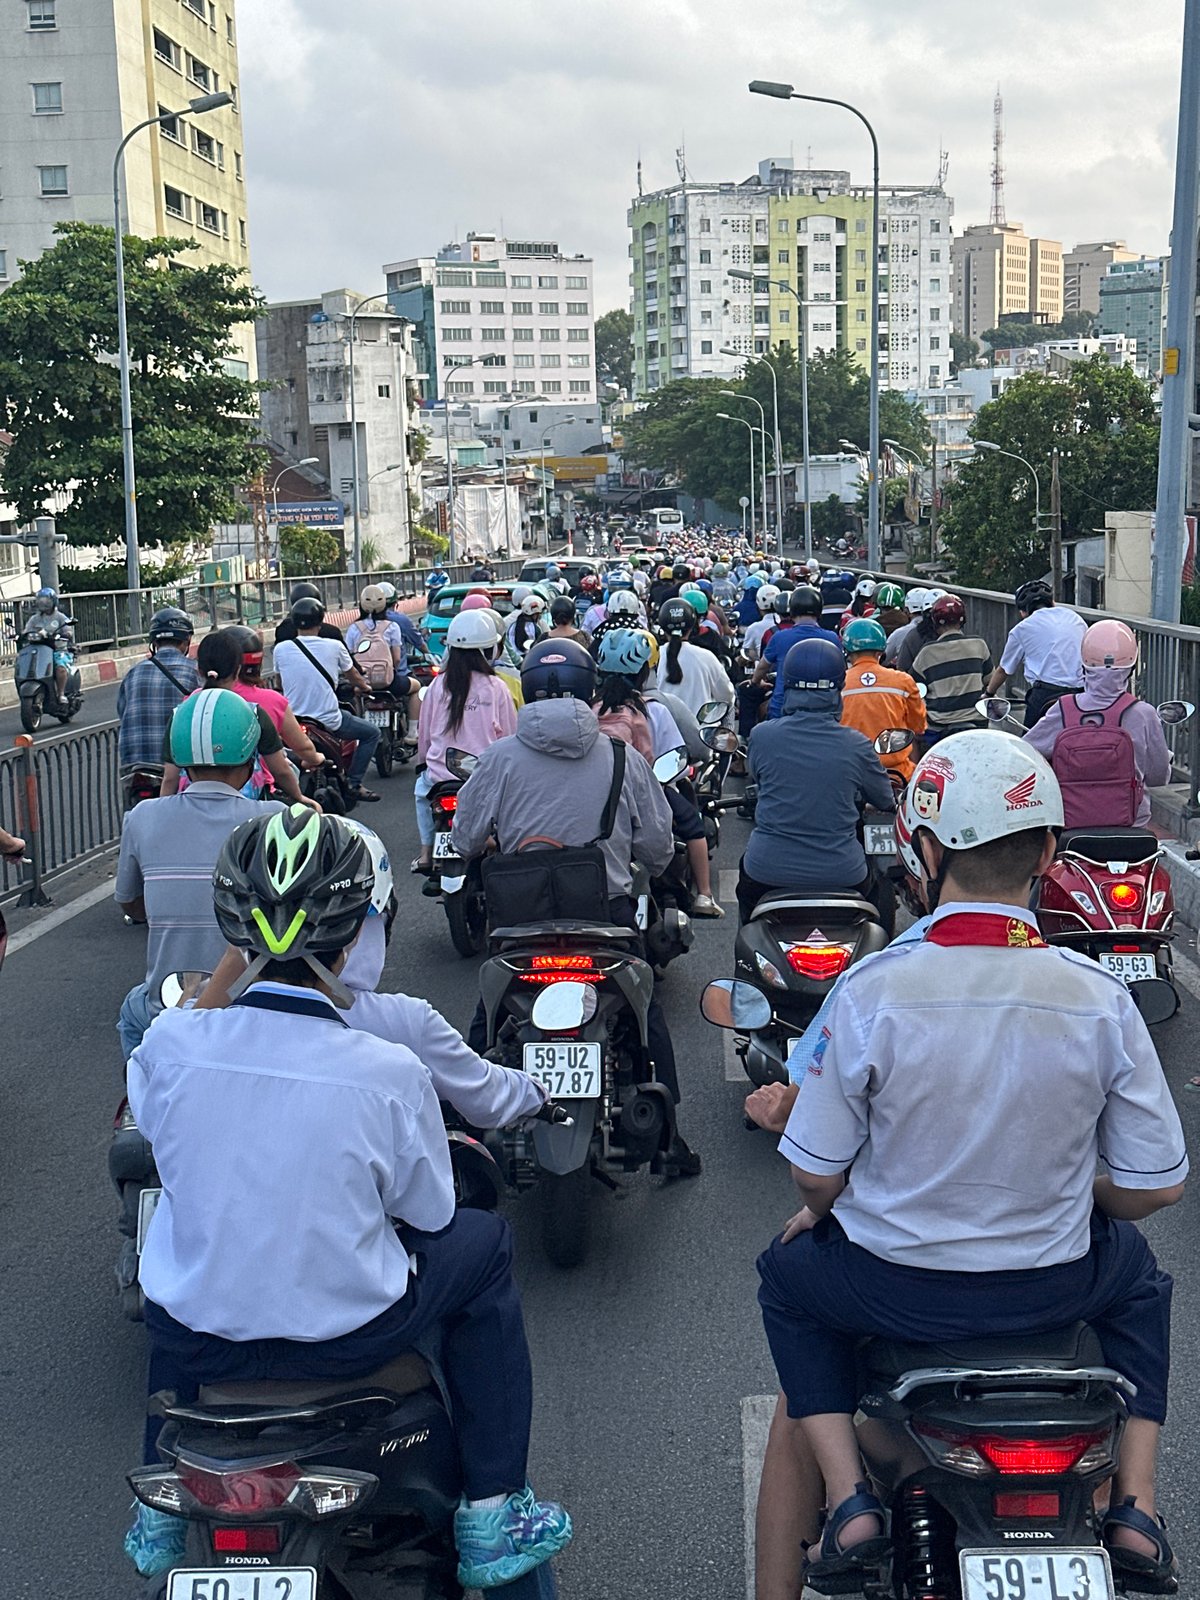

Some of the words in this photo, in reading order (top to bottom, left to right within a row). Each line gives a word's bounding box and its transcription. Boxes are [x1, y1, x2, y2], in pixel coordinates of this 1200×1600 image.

[1006, 800, 1044, 811] HONDA
[1107, 956, 1148, 972] 59-G3
[535, 1046, 589, 1069] 59-U2
[531, 1071, 594, 1094] 57.87
[1003, 1531, 1055, 1539] HONDA
[225, 1556, 271, 1565] HONDA
[982, 1556, 1091, 1600] 59-L3
